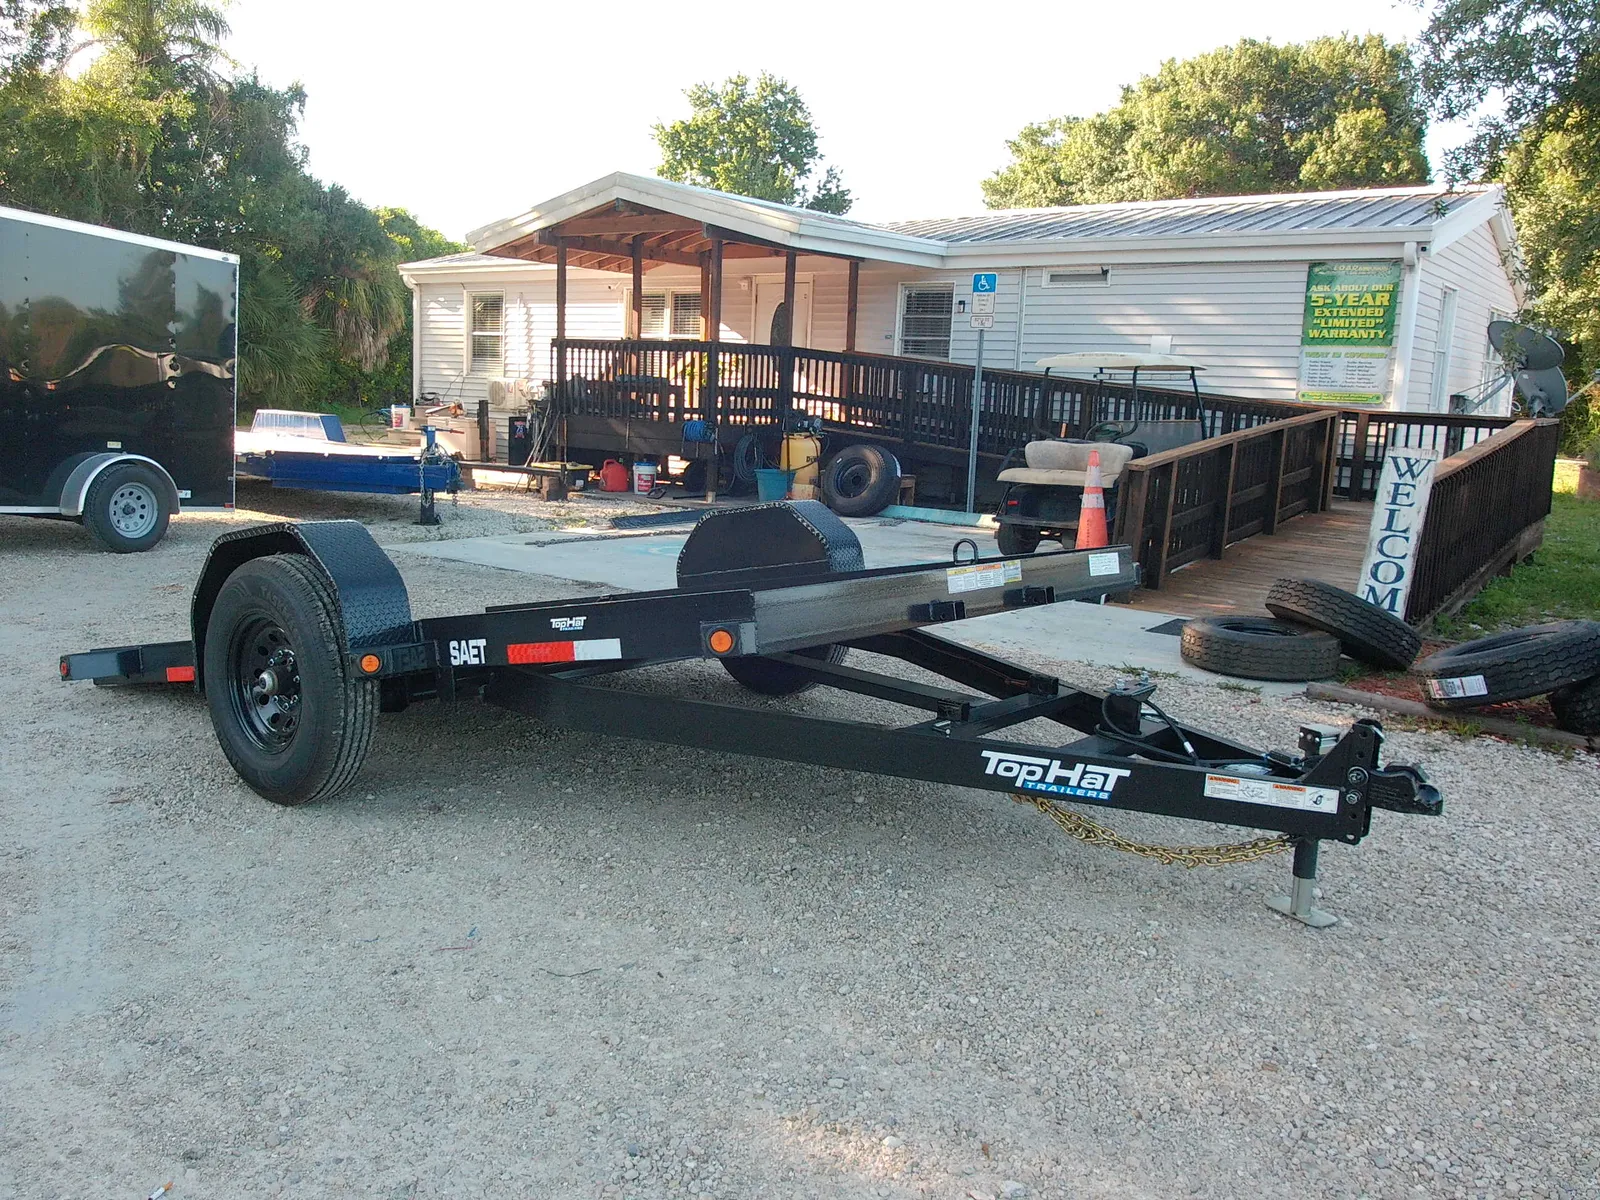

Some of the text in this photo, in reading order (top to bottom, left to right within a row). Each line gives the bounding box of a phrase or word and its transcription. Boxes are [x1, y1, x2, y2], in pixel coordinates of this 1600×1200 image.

[1371, 284, 1394, 292] OUR
[1310, 292, 1390, 306] 5-YEAR
[1314, 308, 1385, 317] EXTENDED
[1308, 329, 1387, 339] WARRANTY
[449, 639, 487, 666] SAET
[1026, 781, 1110, 800] TRAILERS
